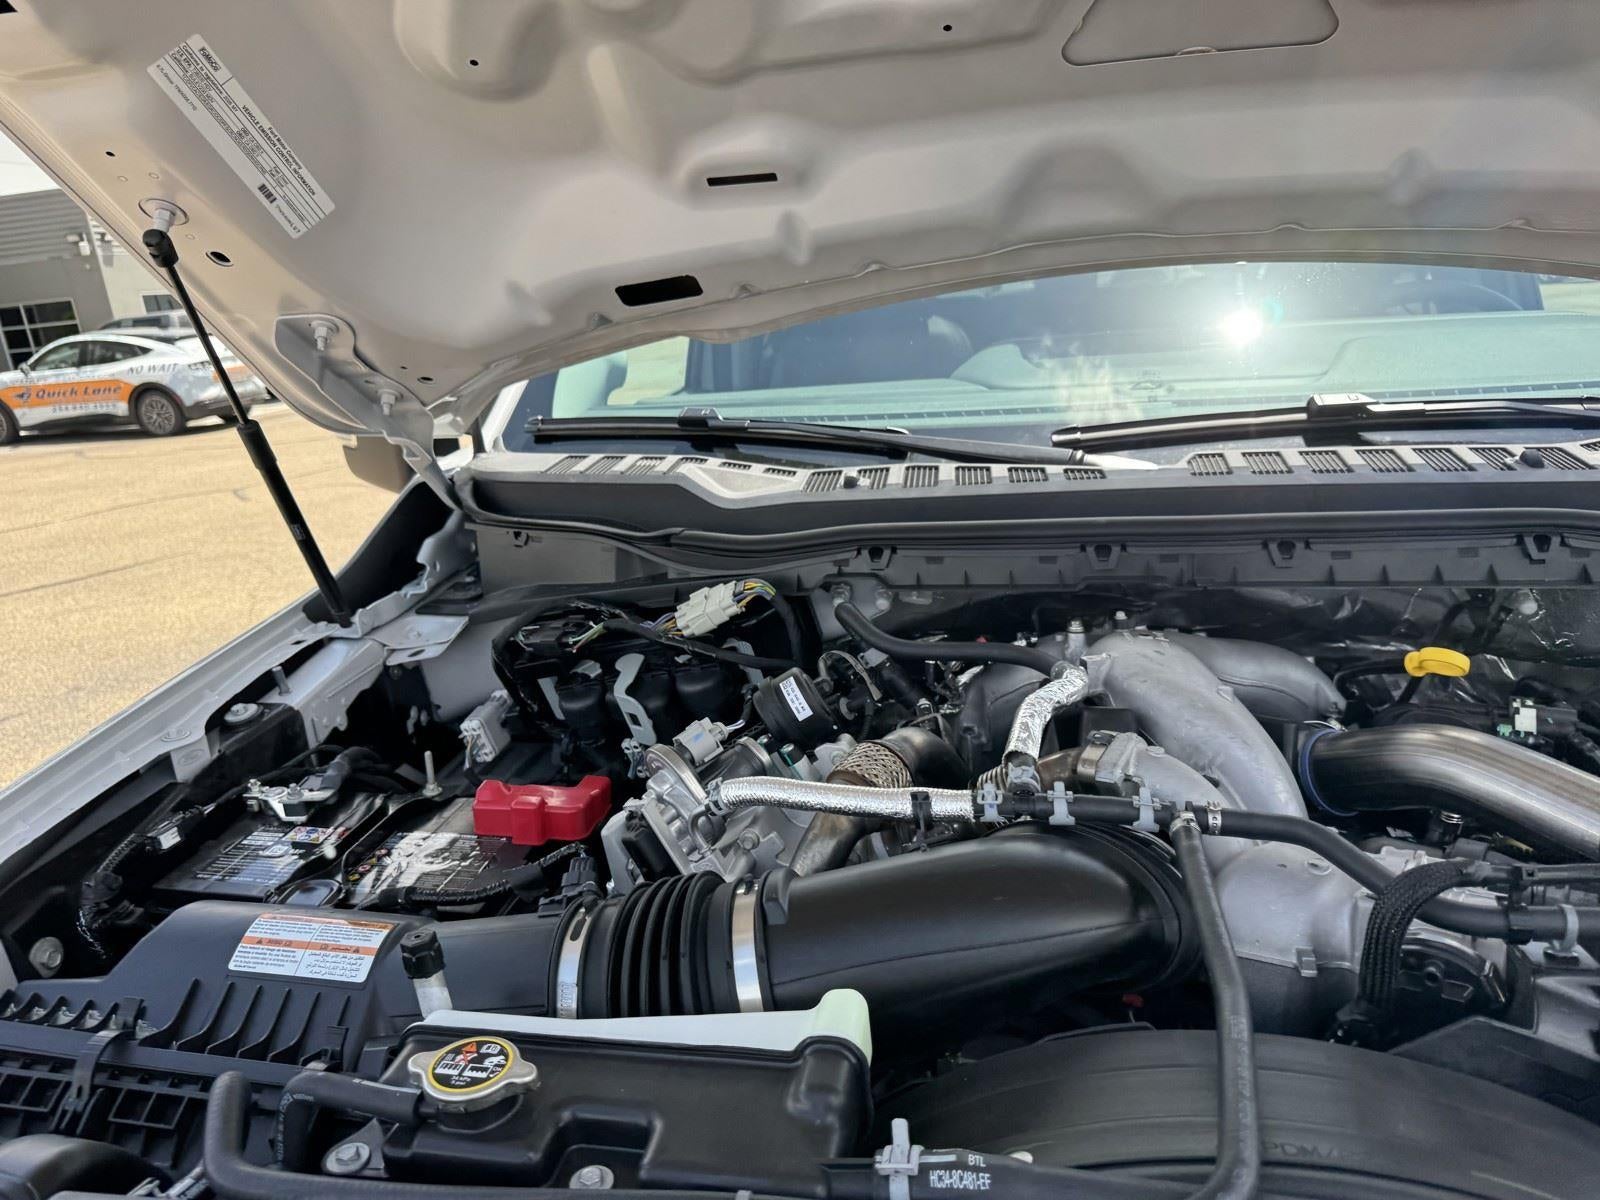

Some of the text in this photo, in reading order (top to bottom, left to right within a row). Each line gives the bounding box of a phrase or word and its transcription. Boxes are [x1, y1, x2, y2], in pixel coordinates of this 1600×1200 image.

[198, 46, 221, 72] FoMoCo
[241, 104, 260, 126] VEHICLE
[257, 124, 277, 147] EMISSION
[274, 146, 294, 168] CONTROL
[291, 167, 316, 196] INFORMATION
[275, 136, 287, 150] Motor
[285, 149, 303, 170] Company
[127, 366, 144, 375] NO
[148, 363, 179, 374] WAIT
[36, 384, 122, 400] Quick Lane
[968, 1154, 986, 1168] BTL
